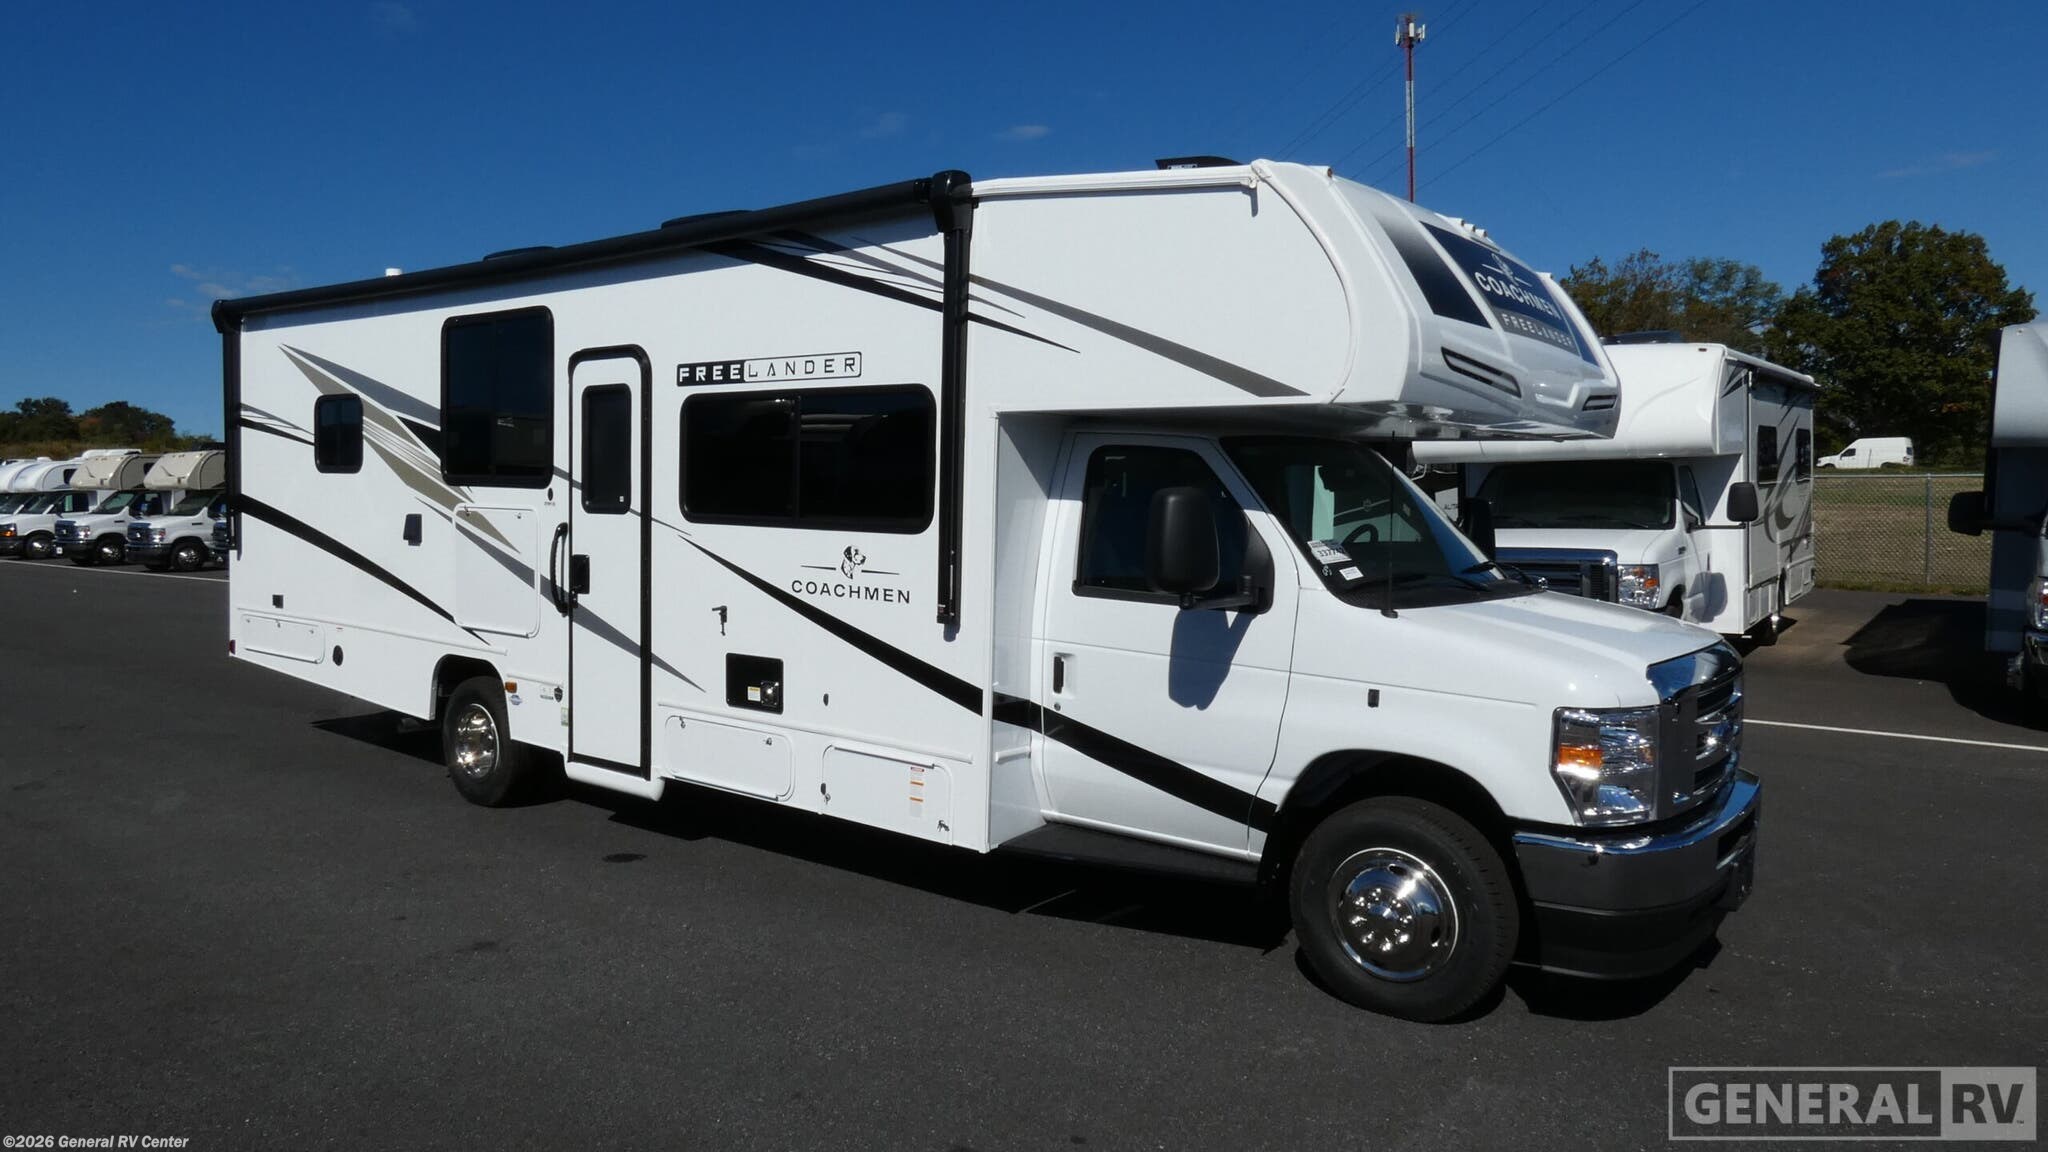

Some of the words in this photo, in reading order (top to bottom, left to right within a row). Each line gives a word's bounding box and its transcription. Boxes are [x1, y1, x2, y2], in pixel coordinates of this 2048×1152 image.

[1475, 271, 1562, 320] COACHMEN
[679, 357, 856, 383] FREELANDER
[791, 579, 910, 604] COACHMEN
